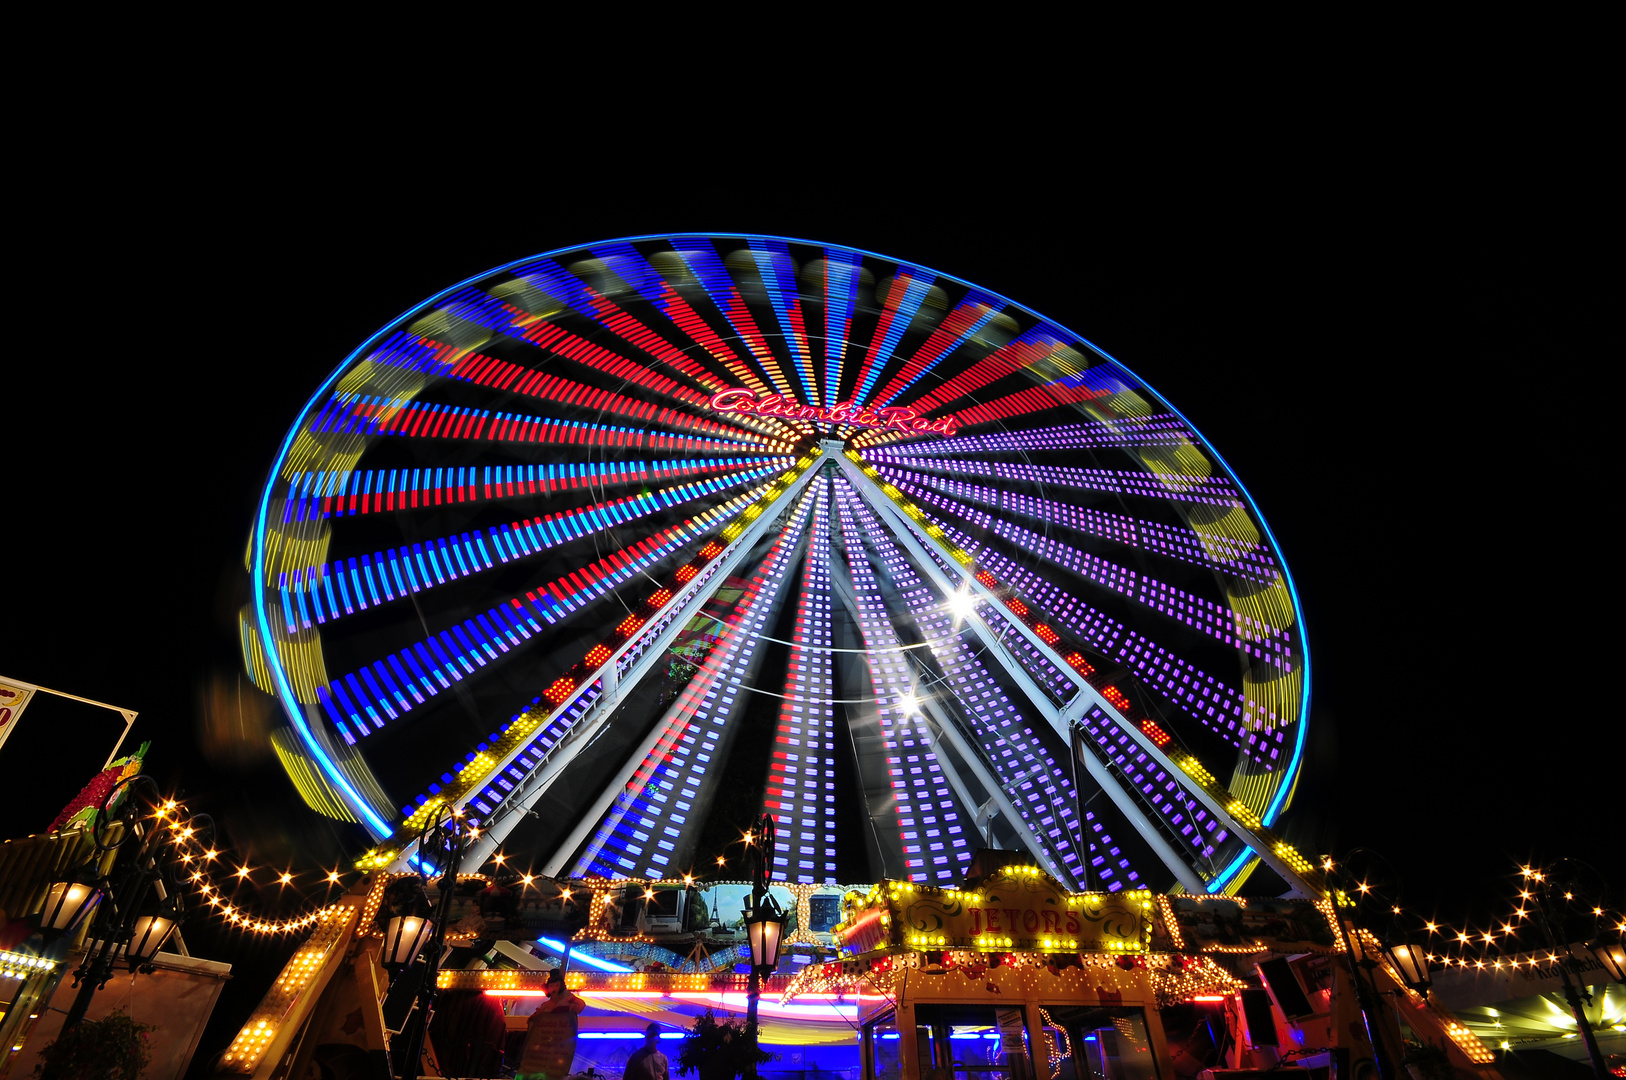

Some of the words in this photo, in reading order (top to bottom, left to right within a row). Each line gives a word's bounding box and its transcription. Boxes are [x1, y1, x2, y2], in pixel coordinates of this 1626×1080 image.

[711, 387, 881, 426] Columbia
[879, 406, 958, 437] Rad
[968, 907, 1082, 936] JETONS
